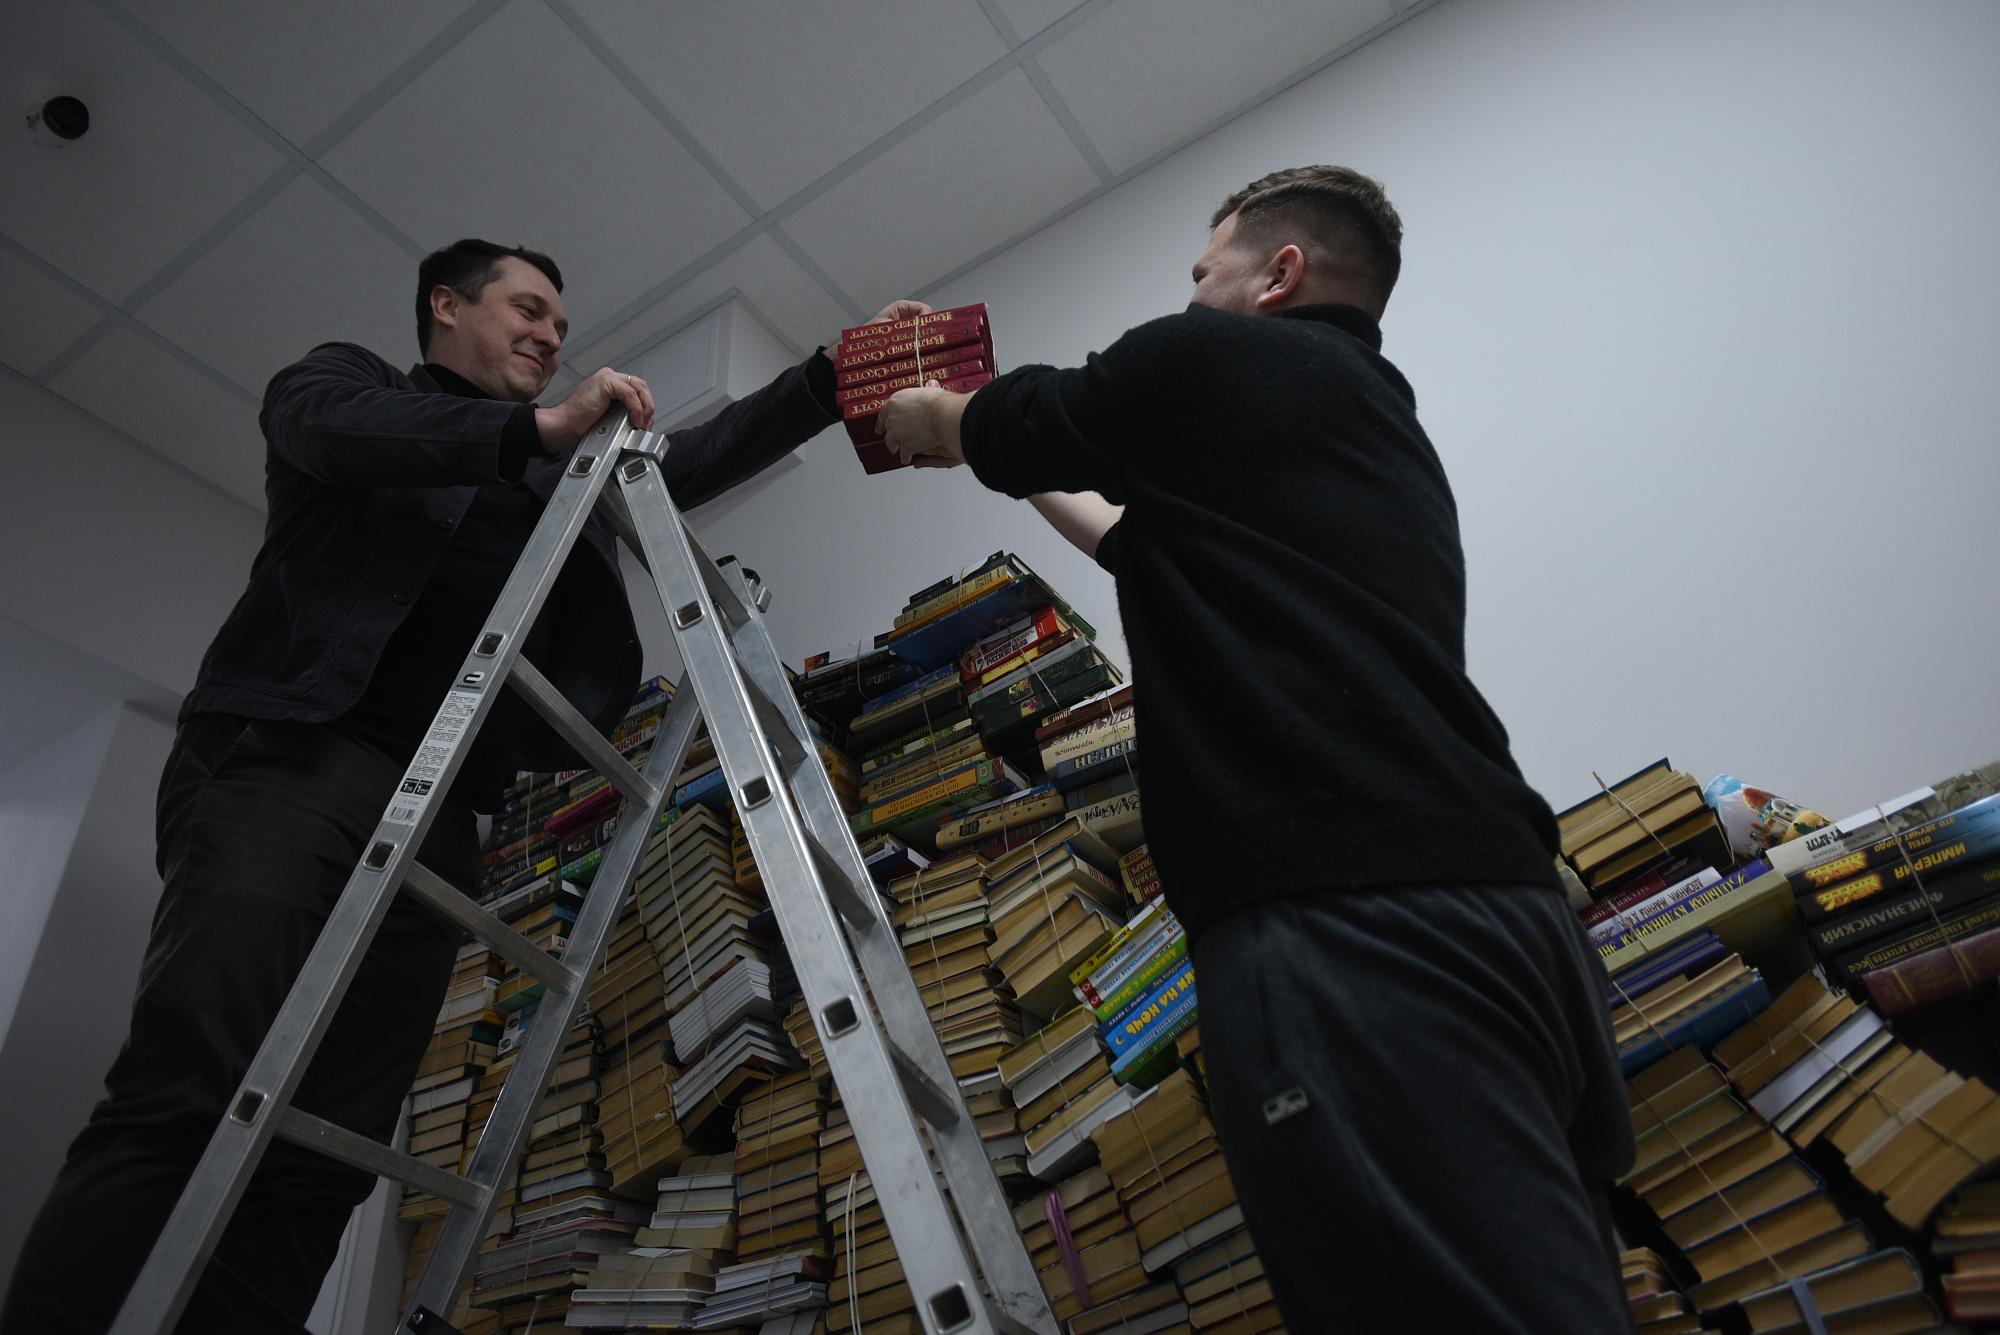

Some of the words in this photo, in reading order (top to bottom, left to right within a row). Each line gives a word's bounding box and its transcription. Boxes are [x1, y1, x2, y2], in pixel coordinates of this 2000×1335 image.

[851, 398, 885, 414] КОТТ
[1894, 842, 1965, 878] ИМПЕРИЯ
[1821, 898, 1923, 944] НЕЗНАНСКИЙ
[1157, 987, 1176, 1008] НА
[1124, 1002, 1160, 1036] НОЧЬ
